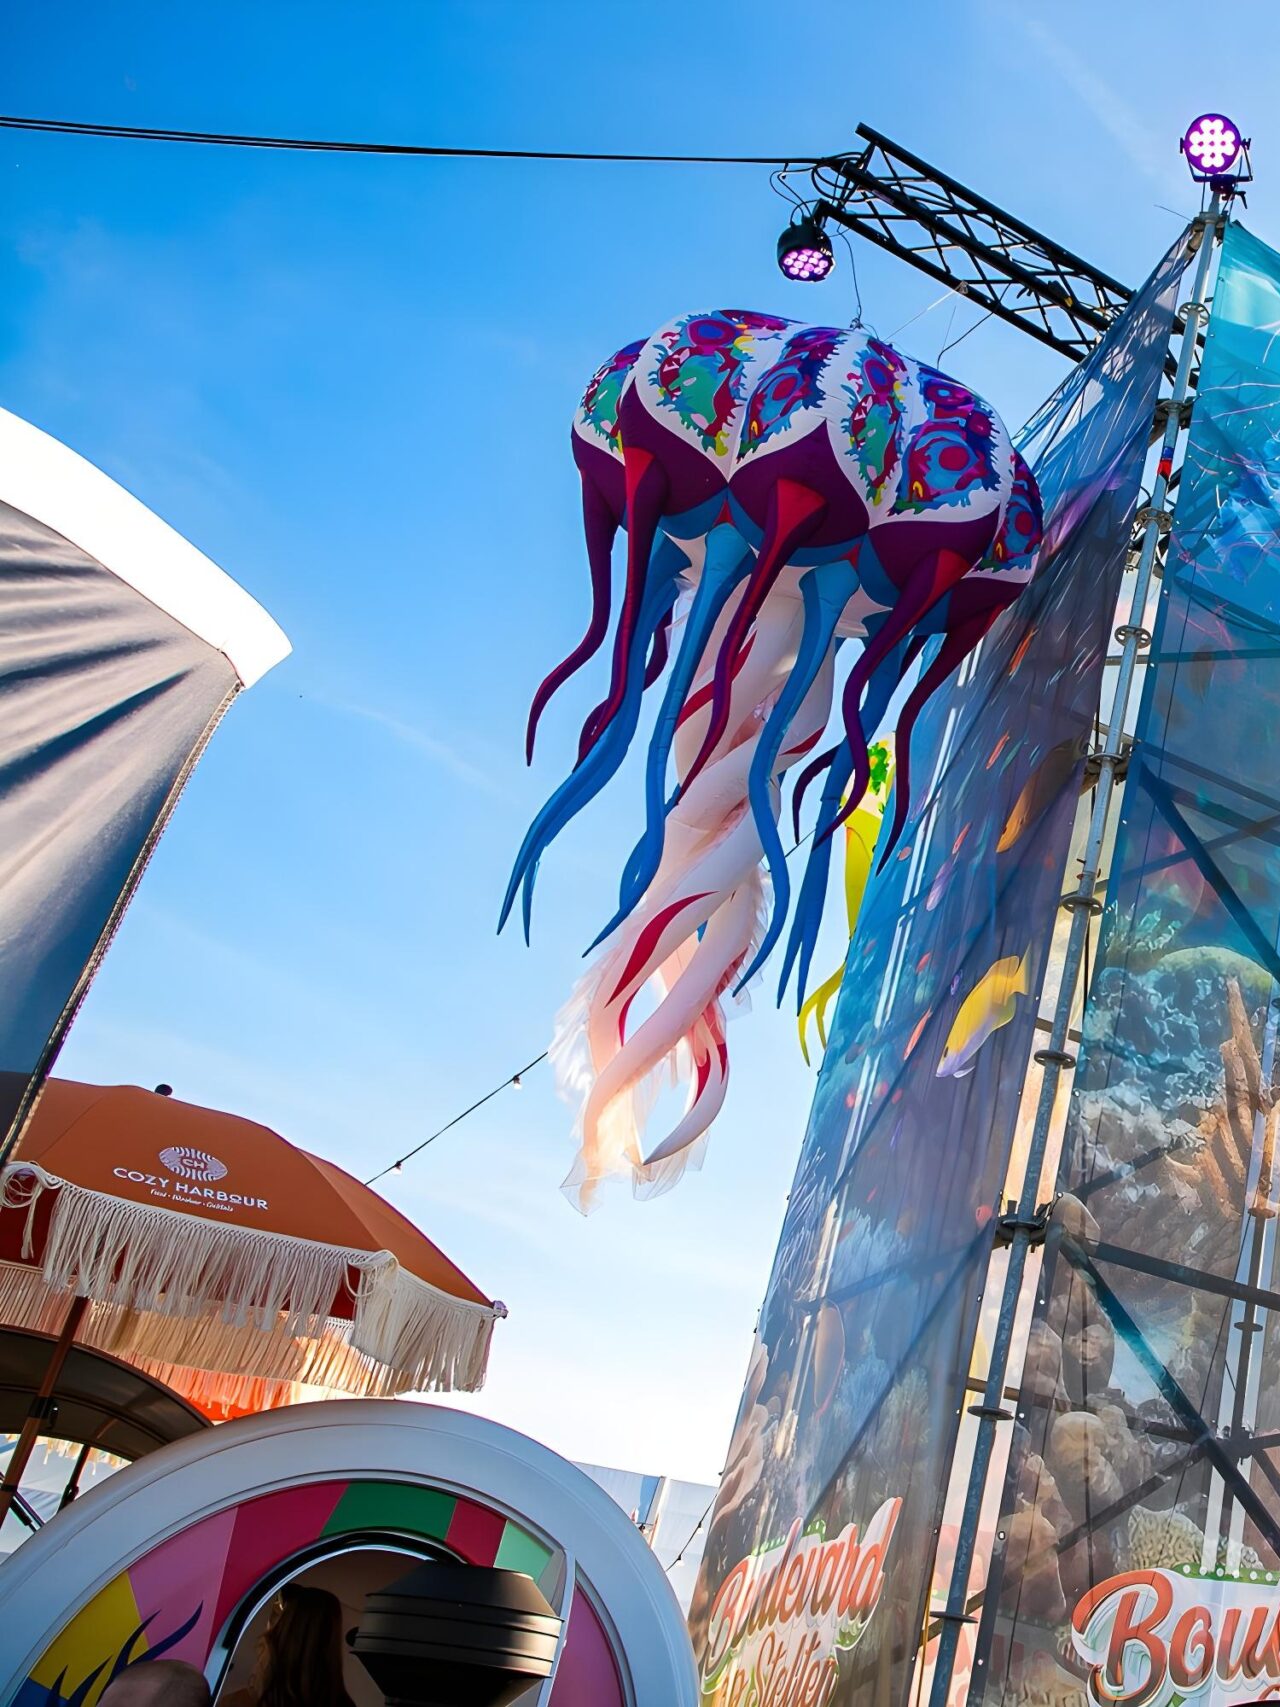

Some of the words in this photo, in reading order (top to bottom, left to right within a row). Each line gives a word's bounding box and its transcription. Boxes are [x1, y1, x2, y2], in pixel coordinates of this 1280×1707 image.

[182, 1158, 205, 1169] CH
[113, 1167, 169, 1188] COZY
[175, 1182, 269, 1210] HARBOUR
